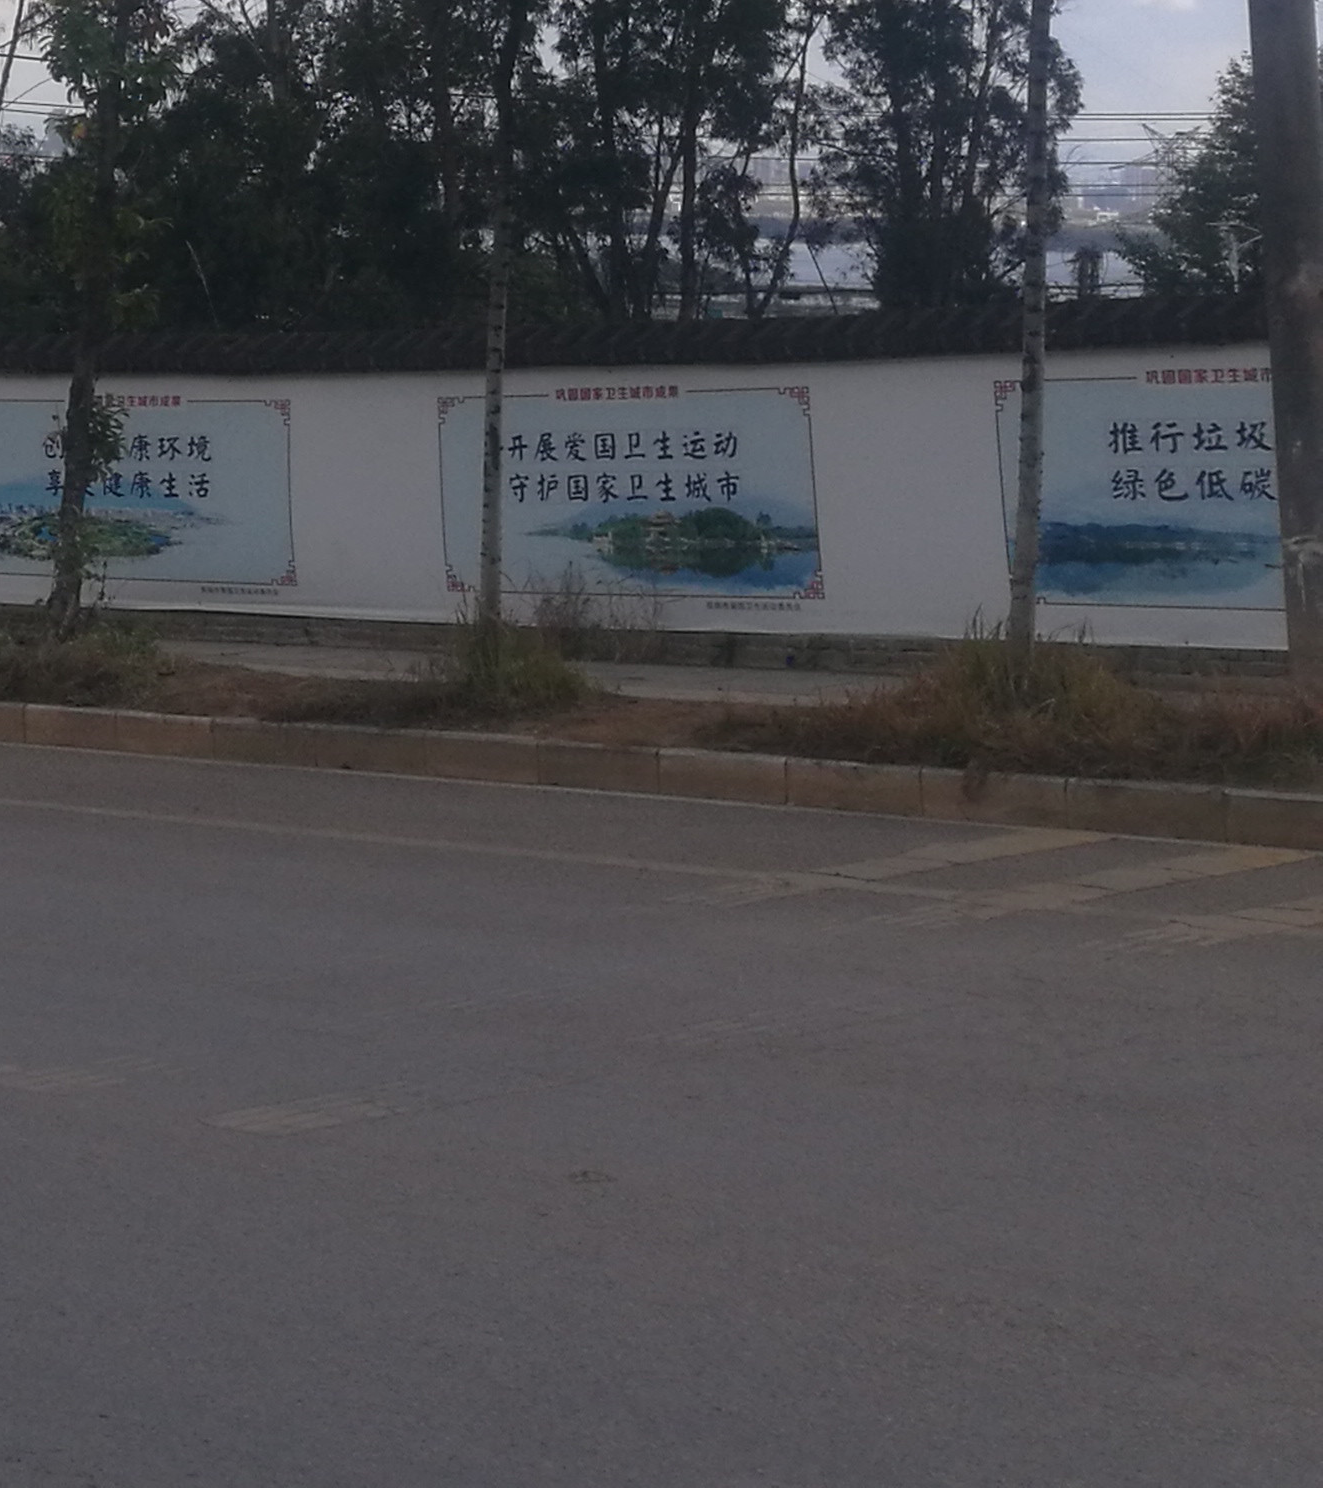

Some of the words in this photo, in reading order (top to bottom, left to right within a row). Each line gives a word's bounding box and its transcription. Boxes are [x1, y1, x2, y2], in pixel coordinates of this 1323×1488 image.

[42, 434, 212, 463] 创康环境
[508, 431, 739, 462] 开展爱国卫生运动
[1108, 420, 1273, 454] 推行垃圾
[45, 469, 210, 499] 享健康生活
[508, 472, 741, 503] 守护国家卫生城市
[1111, 468, 1277, 501] 绿色低碳
